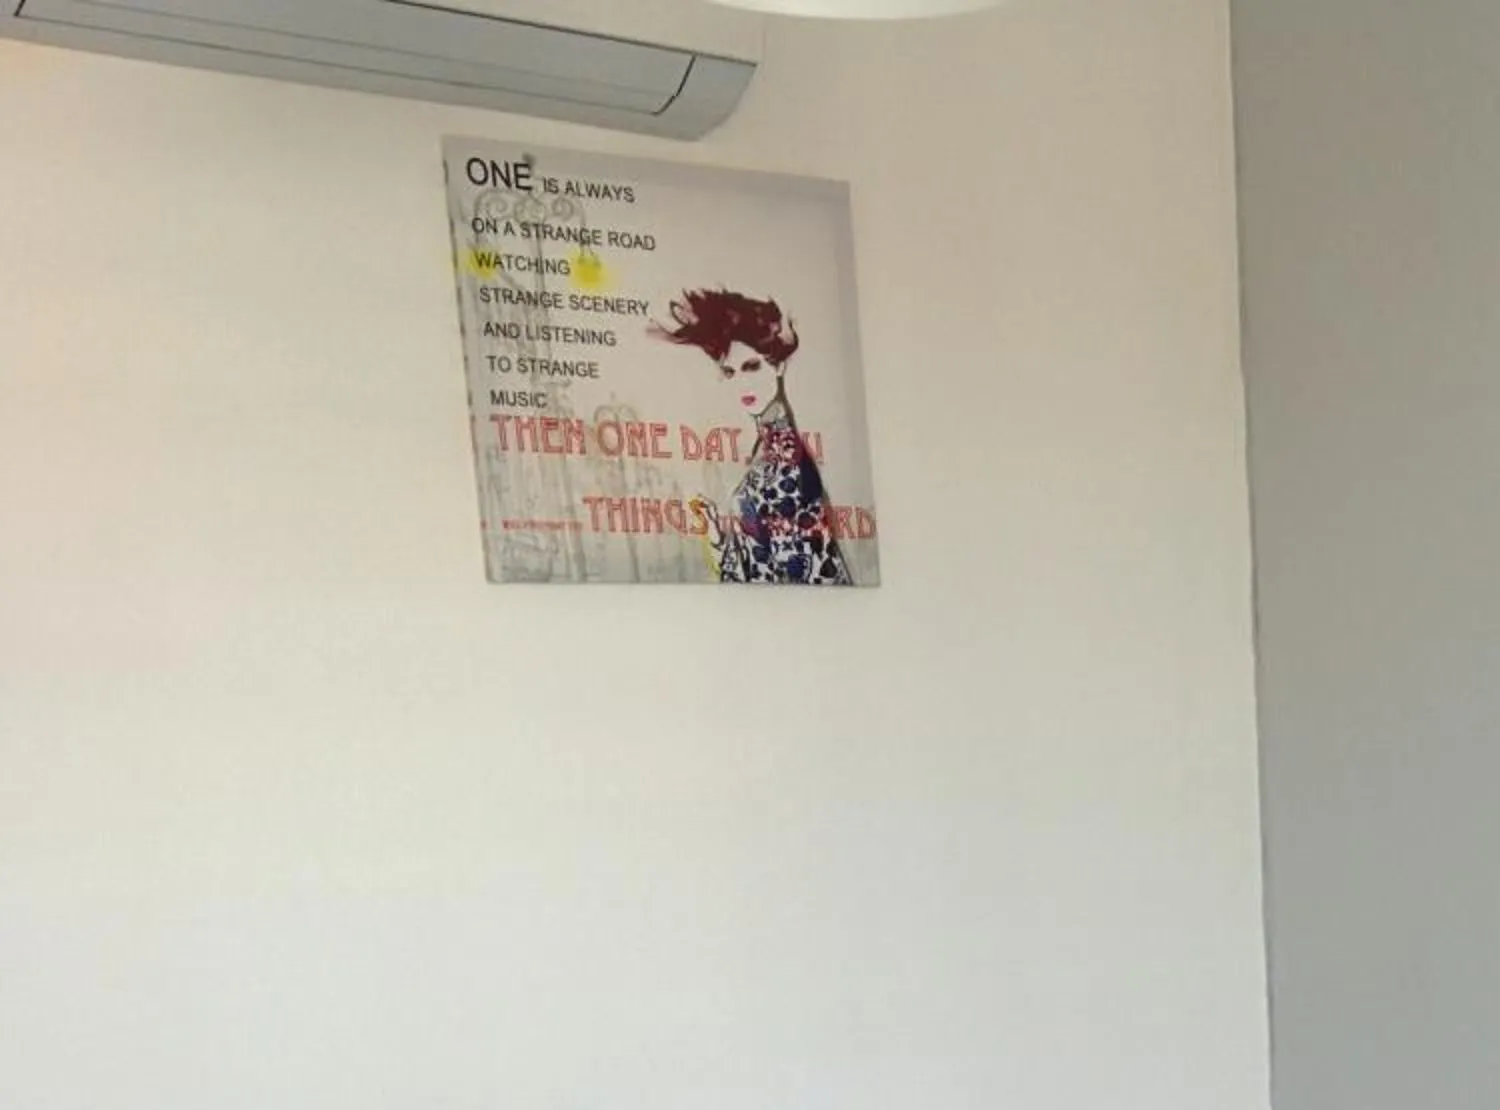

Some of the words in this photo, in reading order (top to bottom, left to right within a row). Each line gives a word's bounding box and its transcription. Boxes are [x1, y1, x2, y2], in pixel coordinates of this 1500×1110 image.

[466, 157, 533, 191] ONE
[543, 177, 559, 194] IS
[564, 179, 635, 203] ALWAYS
[472, 217, 498, 235] ON
[503, 221, 516, 236] A
[520, 222, 603, 246] STRANGE
[608, 231, 656, 251] ROAD
[475, 252, 570, 275] WATCHING
[480, 287, 564, 310] STRANGE
[568, 294, 650, 316] SCENERY
[484, 321, 520, 339] AND
[526, 325, 617, 347] LISTENING
[486, 355, 511, 373] TO
[517, 357, 600, 379] STRANGE
[490, 390, 548, 409] MUSIC
[490, 413, 587, 455] THEN
[597, 421, 672, 458] ONE
[582, 497, 709, 536] THINGS
